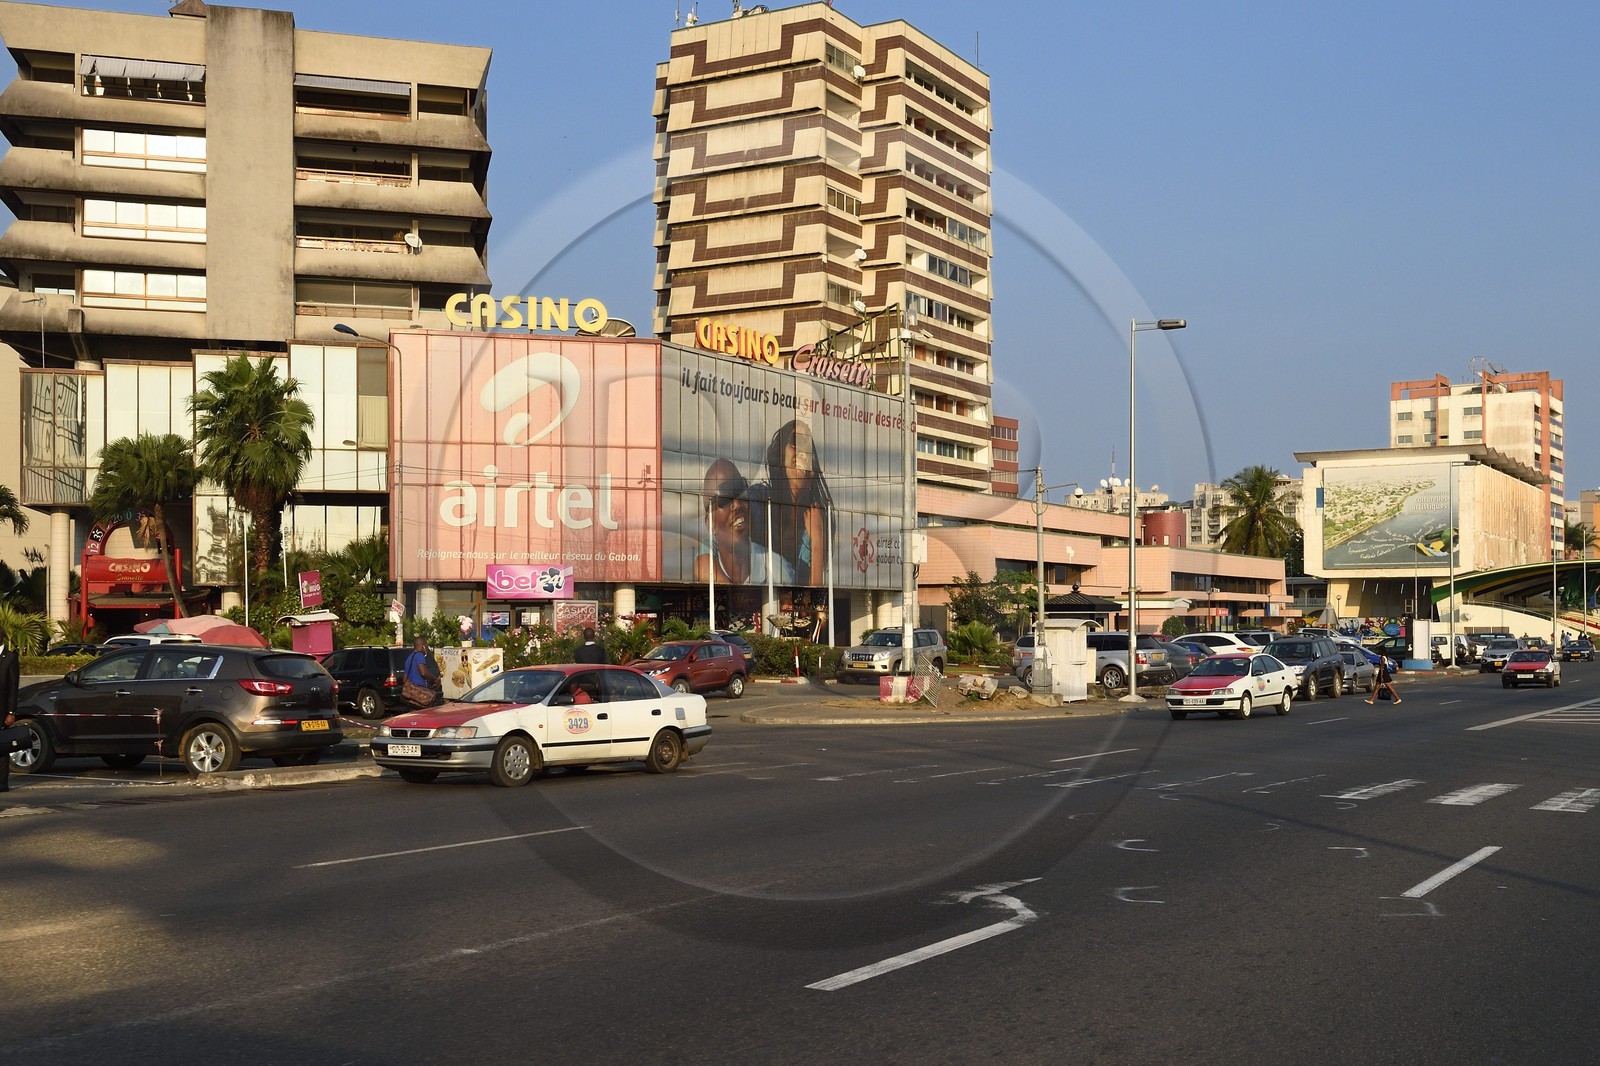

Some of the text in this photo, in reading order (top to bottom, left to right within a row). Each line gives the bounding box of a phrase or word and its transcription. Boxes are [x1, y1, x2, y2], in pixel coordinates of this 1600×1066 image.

[445, 293, 608, 332] CASINO
[695, 317, 873, 386] CASINO Croisette
[681, 367, 691, 388] il
[691, 371, 718, 397] fait
[719, 378, 770, 405] toujours
[772, 387, 800, 410] beau
[822, 398, 831, 417] le
[833, 402, 874, 425] meilleur
[875, 409, 891, 429] des
[439, 464, 619, 531] airtel
[93, 529, 104, 542] 35
[417, 548, 489, 561] Rejoignez-nous
[491, 551, 506, 561] sur
[509, 550, 519, 560] le
[521, 550, 560, 561] meilleur
[561, 551, 592, 561] réseau
[594, 551, 606, 561] du
[108, 562, 151, 573] CASINO
[556, 606, 596, 614] CASINO
[568, 717, 589, 730] 3429
